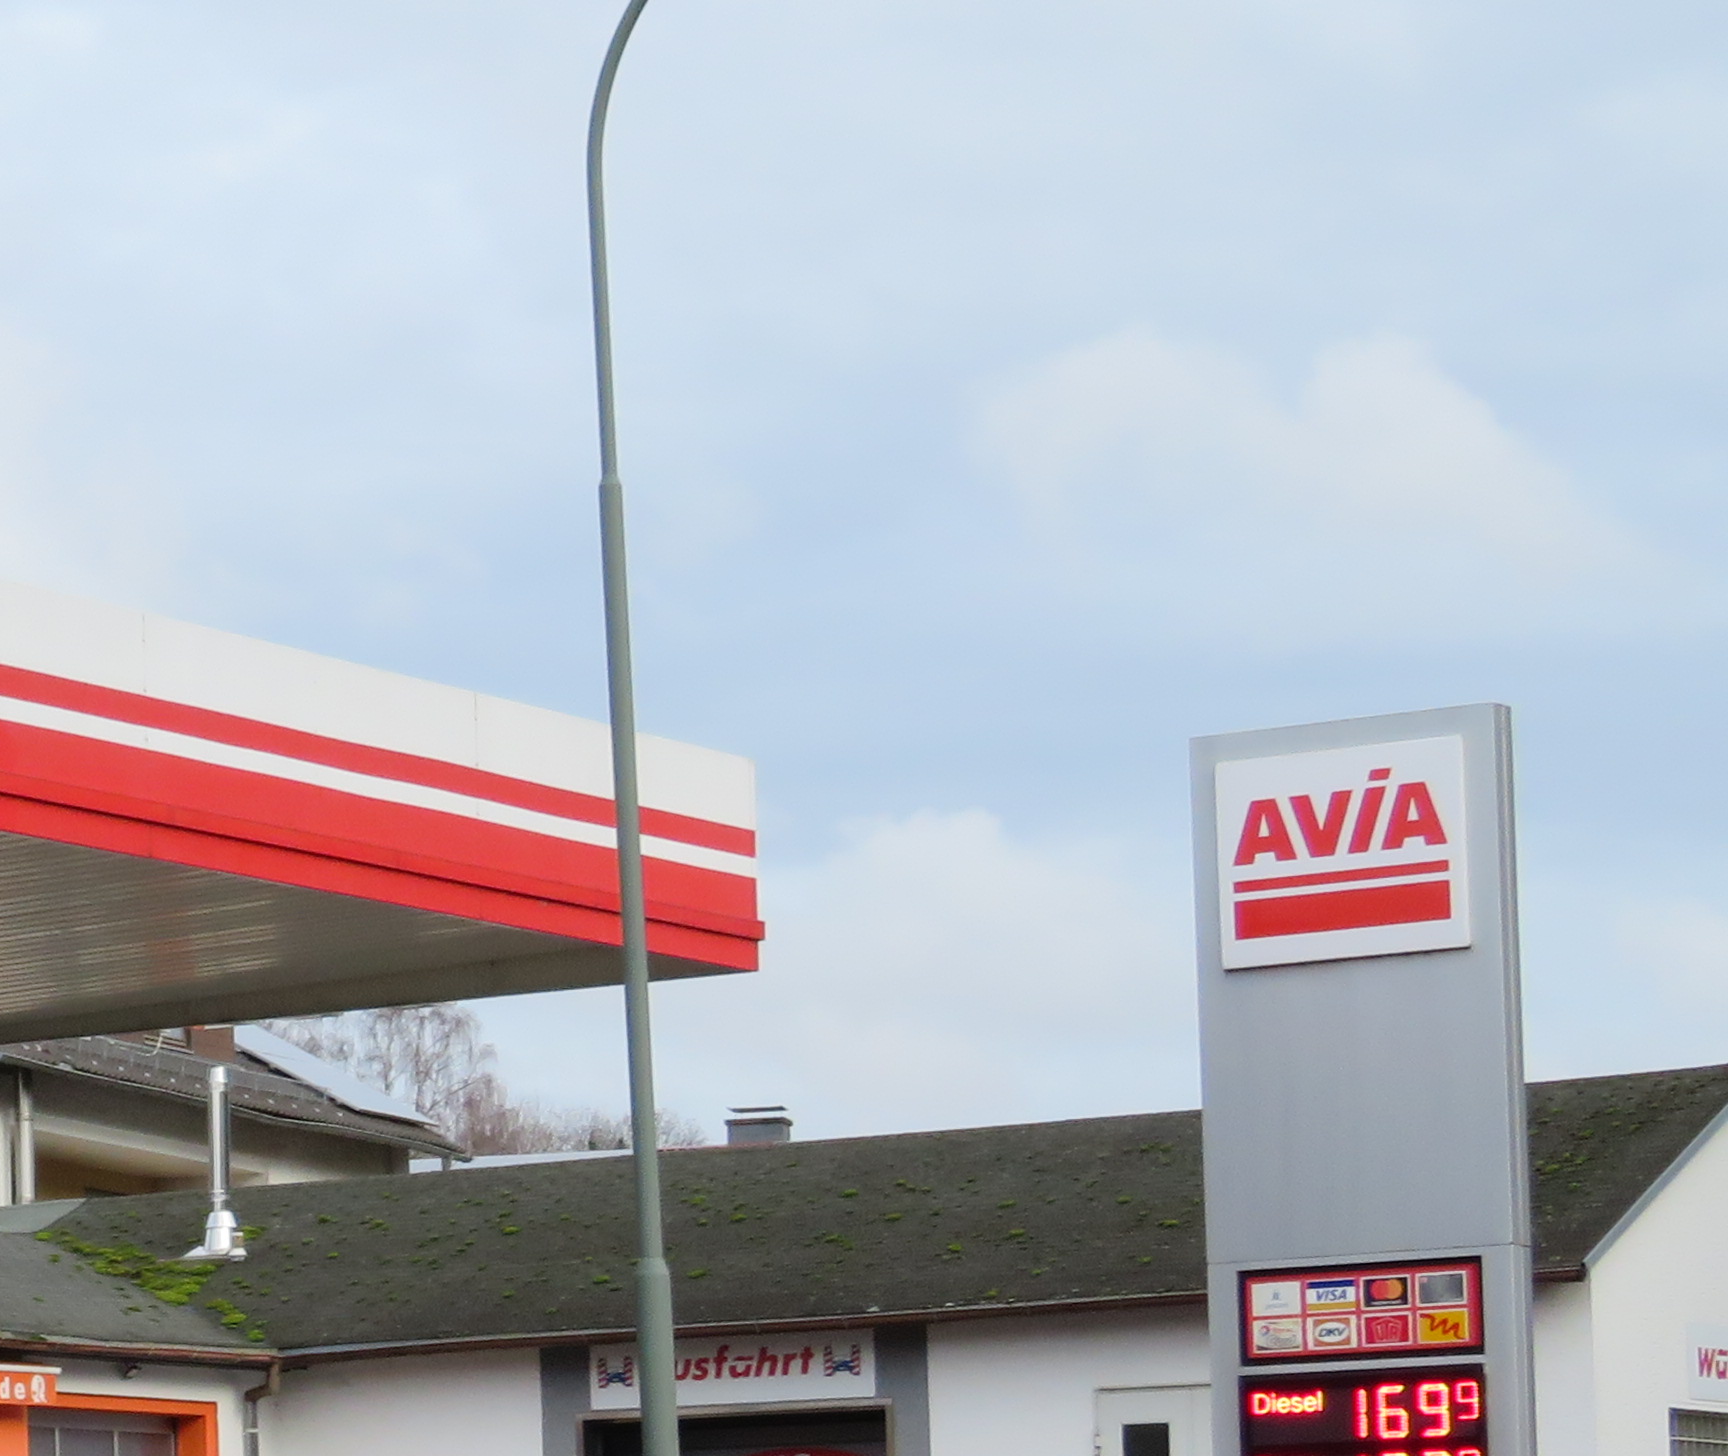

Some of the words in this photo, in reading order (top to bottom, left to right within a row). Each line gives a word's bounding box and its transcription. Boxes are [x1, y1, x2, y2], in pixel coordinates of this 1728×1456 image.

[1233, 767, 1448, 867] AVIA
[1314, 1288, 1348, 1302] VISA
[674, 1344, 815, 1382] usfahrt
[1250, 1389, 1325, 1416] Diesel
